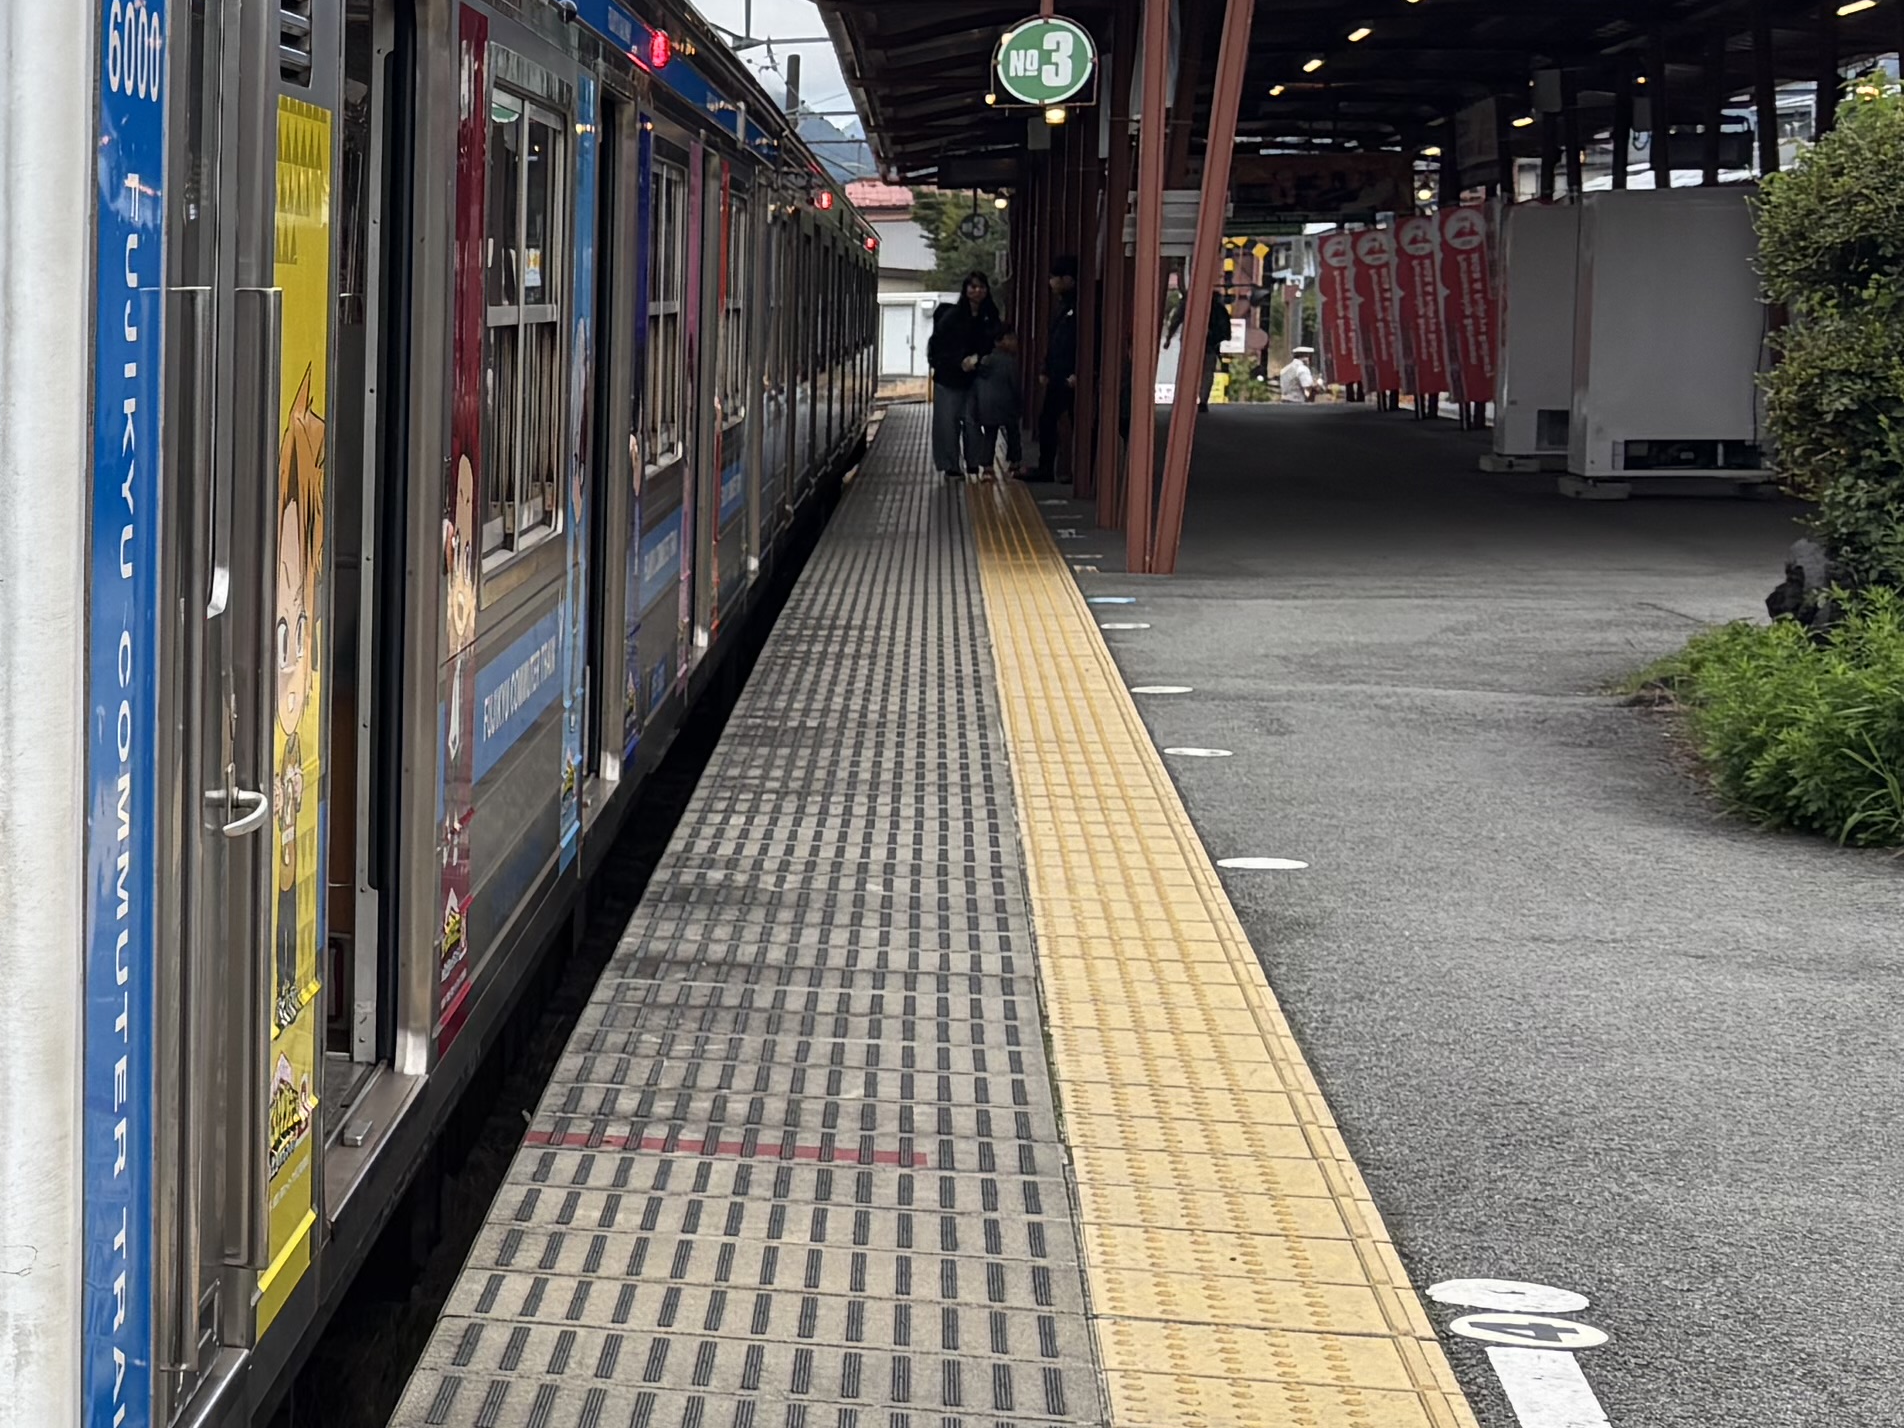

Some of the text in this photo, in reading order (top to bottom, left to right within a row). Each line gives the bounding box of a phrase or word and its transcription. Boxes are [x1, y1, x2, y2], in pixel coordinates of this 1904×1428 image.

[1041, 31, 1074, 87] 3
[120, 173, 139, 579] FUJIKYU
[113, 630, 131, 1179] COMMUTER
